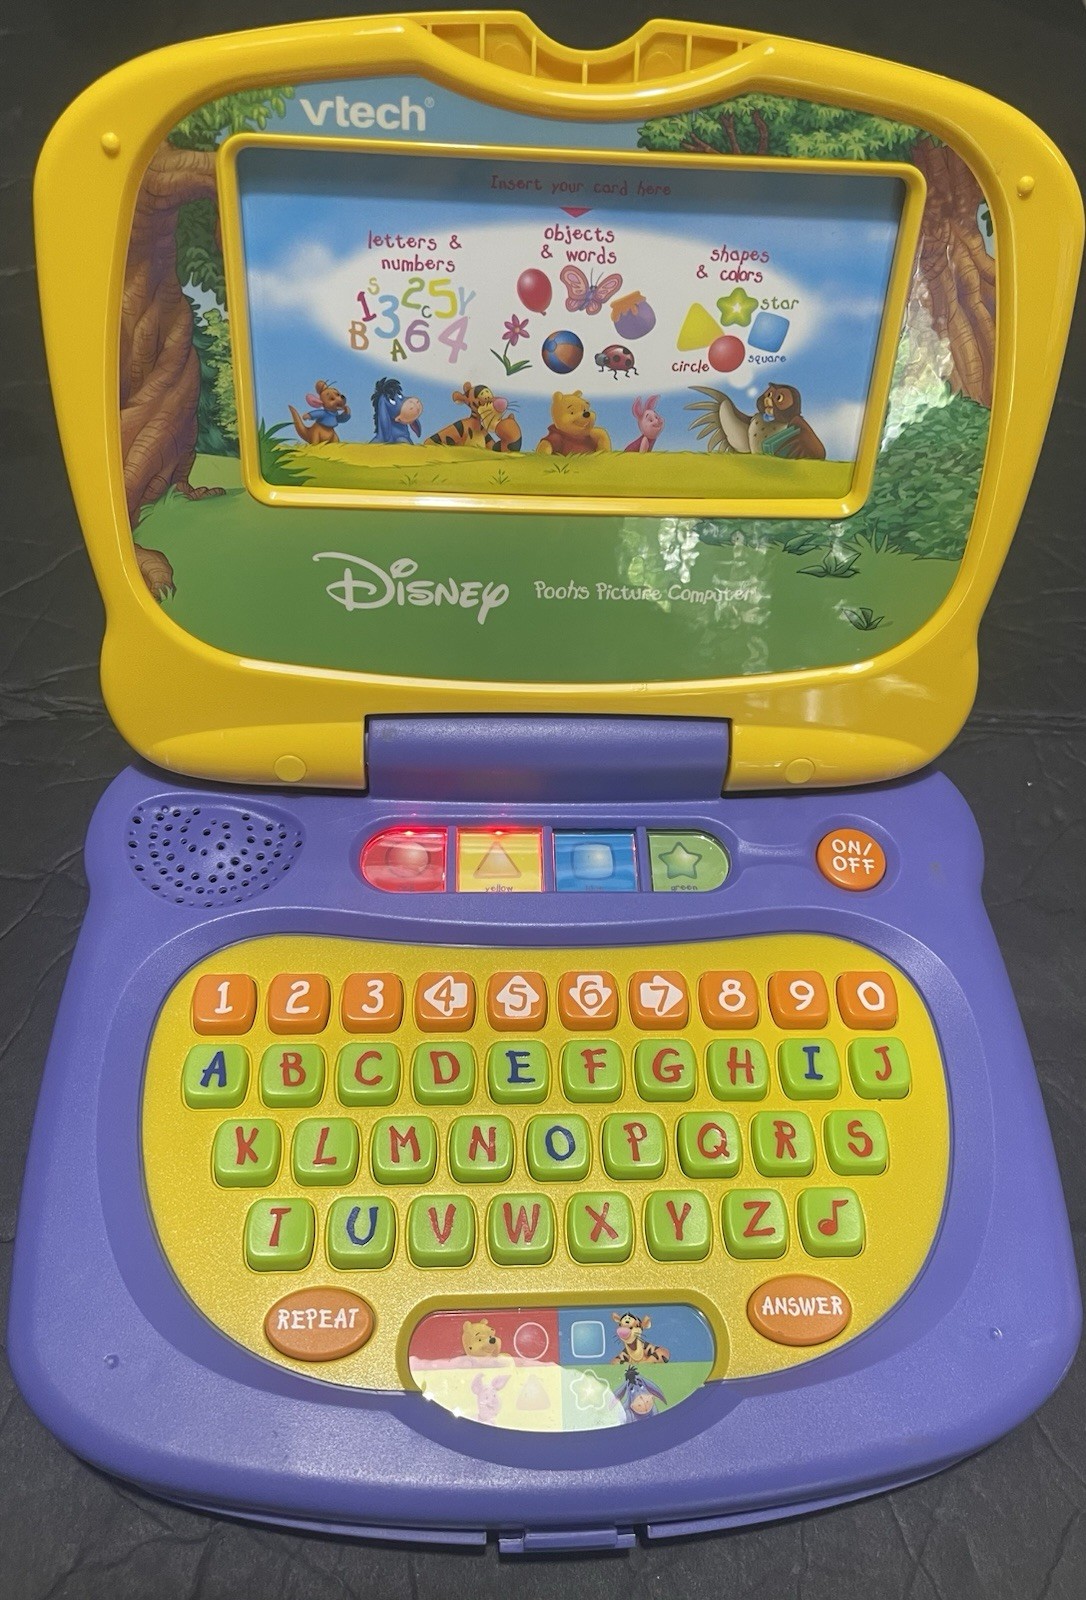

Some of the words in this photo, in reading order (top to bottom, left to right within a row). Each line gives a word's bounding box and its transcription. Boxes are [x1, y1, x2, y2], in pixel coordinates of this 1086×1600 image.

[300, 96, 426, 131] vtech
[490, 175, 542, 191] Insert
[552, 181, 584, 195] your
[593, 180, 627, 196] card
[637, 181, 671, 196] here
[368, 230, 437, 251] letters
[449, 235, 462, 249] &
[544, 223, 615, 243] objects
[381, 254, 455, 273] numbers
[541, 245, 553, 259] &
[566, 248, 617, 265] words
[710, 245, 770, 264] shapes
[696, 265, 708, 279] &
[720, 265, 764, 283] colors
[760, 297, 799, 311] star
[374, 294, 399, 339] 3
[348, 320, 369, 350] B
[405, 319, 430, 353] 6
[438, 316, 469, 364] 4
[390, 339, 407, 362] A
[748, 353, 787, 365] square
[671, 360, 710, 374] circle
[595, 582, 662, 601] Picture
[667, 584, 751, 605] Computer
[831, 838, 873, 857] ON/
[832, 855, 875, 875] OFF
[485, 884, 514, 893] yellow
[671, 884, 698, 892] green
[214, 981, 233, 1014] 1
[285, 980, 310, 1014] 2
[361, 979, 384, 1014] 3
[433, 982, 455, 1012] 4
[507, 982, 530, 1011] 5
[579, 980, 602, 1009] 6
[650, 985, 670, 1013] 7
[718, 979, 747, 1012] 8
[789, 980, 815, 1011] 9
[856, 980, 886, 1012] 0
[200, 1051, 227, 1088] A
[280, 1052, 307, 1088] B
[354, 1051, 383, 1086] C
[429, 1051, 460, 1085] D
[505, 1050, 535, 1084] E
[581, 1048, 607, 1084] F
[652, 1048, 685, 1083] G
[727, 1046, 755, 1086] H
[802, 1045, 824, 1080] I
[873, 1045, 892, 1081] J
[235, 1126, 259, 1165] K
[312, 1126, 337, 1166] L
[388, 1125, 421, 1163] M
[468, 1126, 497, 1162] N
[545, 1125, 576, 1162] O
[623, 1122, 648, 1162] P
[697, 1122, 730, 1159] Q
[773, 1120, 797, 1160] R
[847, 1119, 873, 1158] S
[268, 1207, 292, 1247] T
[346, 1206, 379, 1247] U
[428, 1203, 456, 1246] V
[502, 1202, 541, 1244] W
[585, 1202, 619, 1242] X
[666, 1200, 692, 1241] Y
[743, 1201, 776, 1238] Z
[761, 1294, 843, 1318] ANSWER
[277, 1307, 360, 1331] REPEAT
